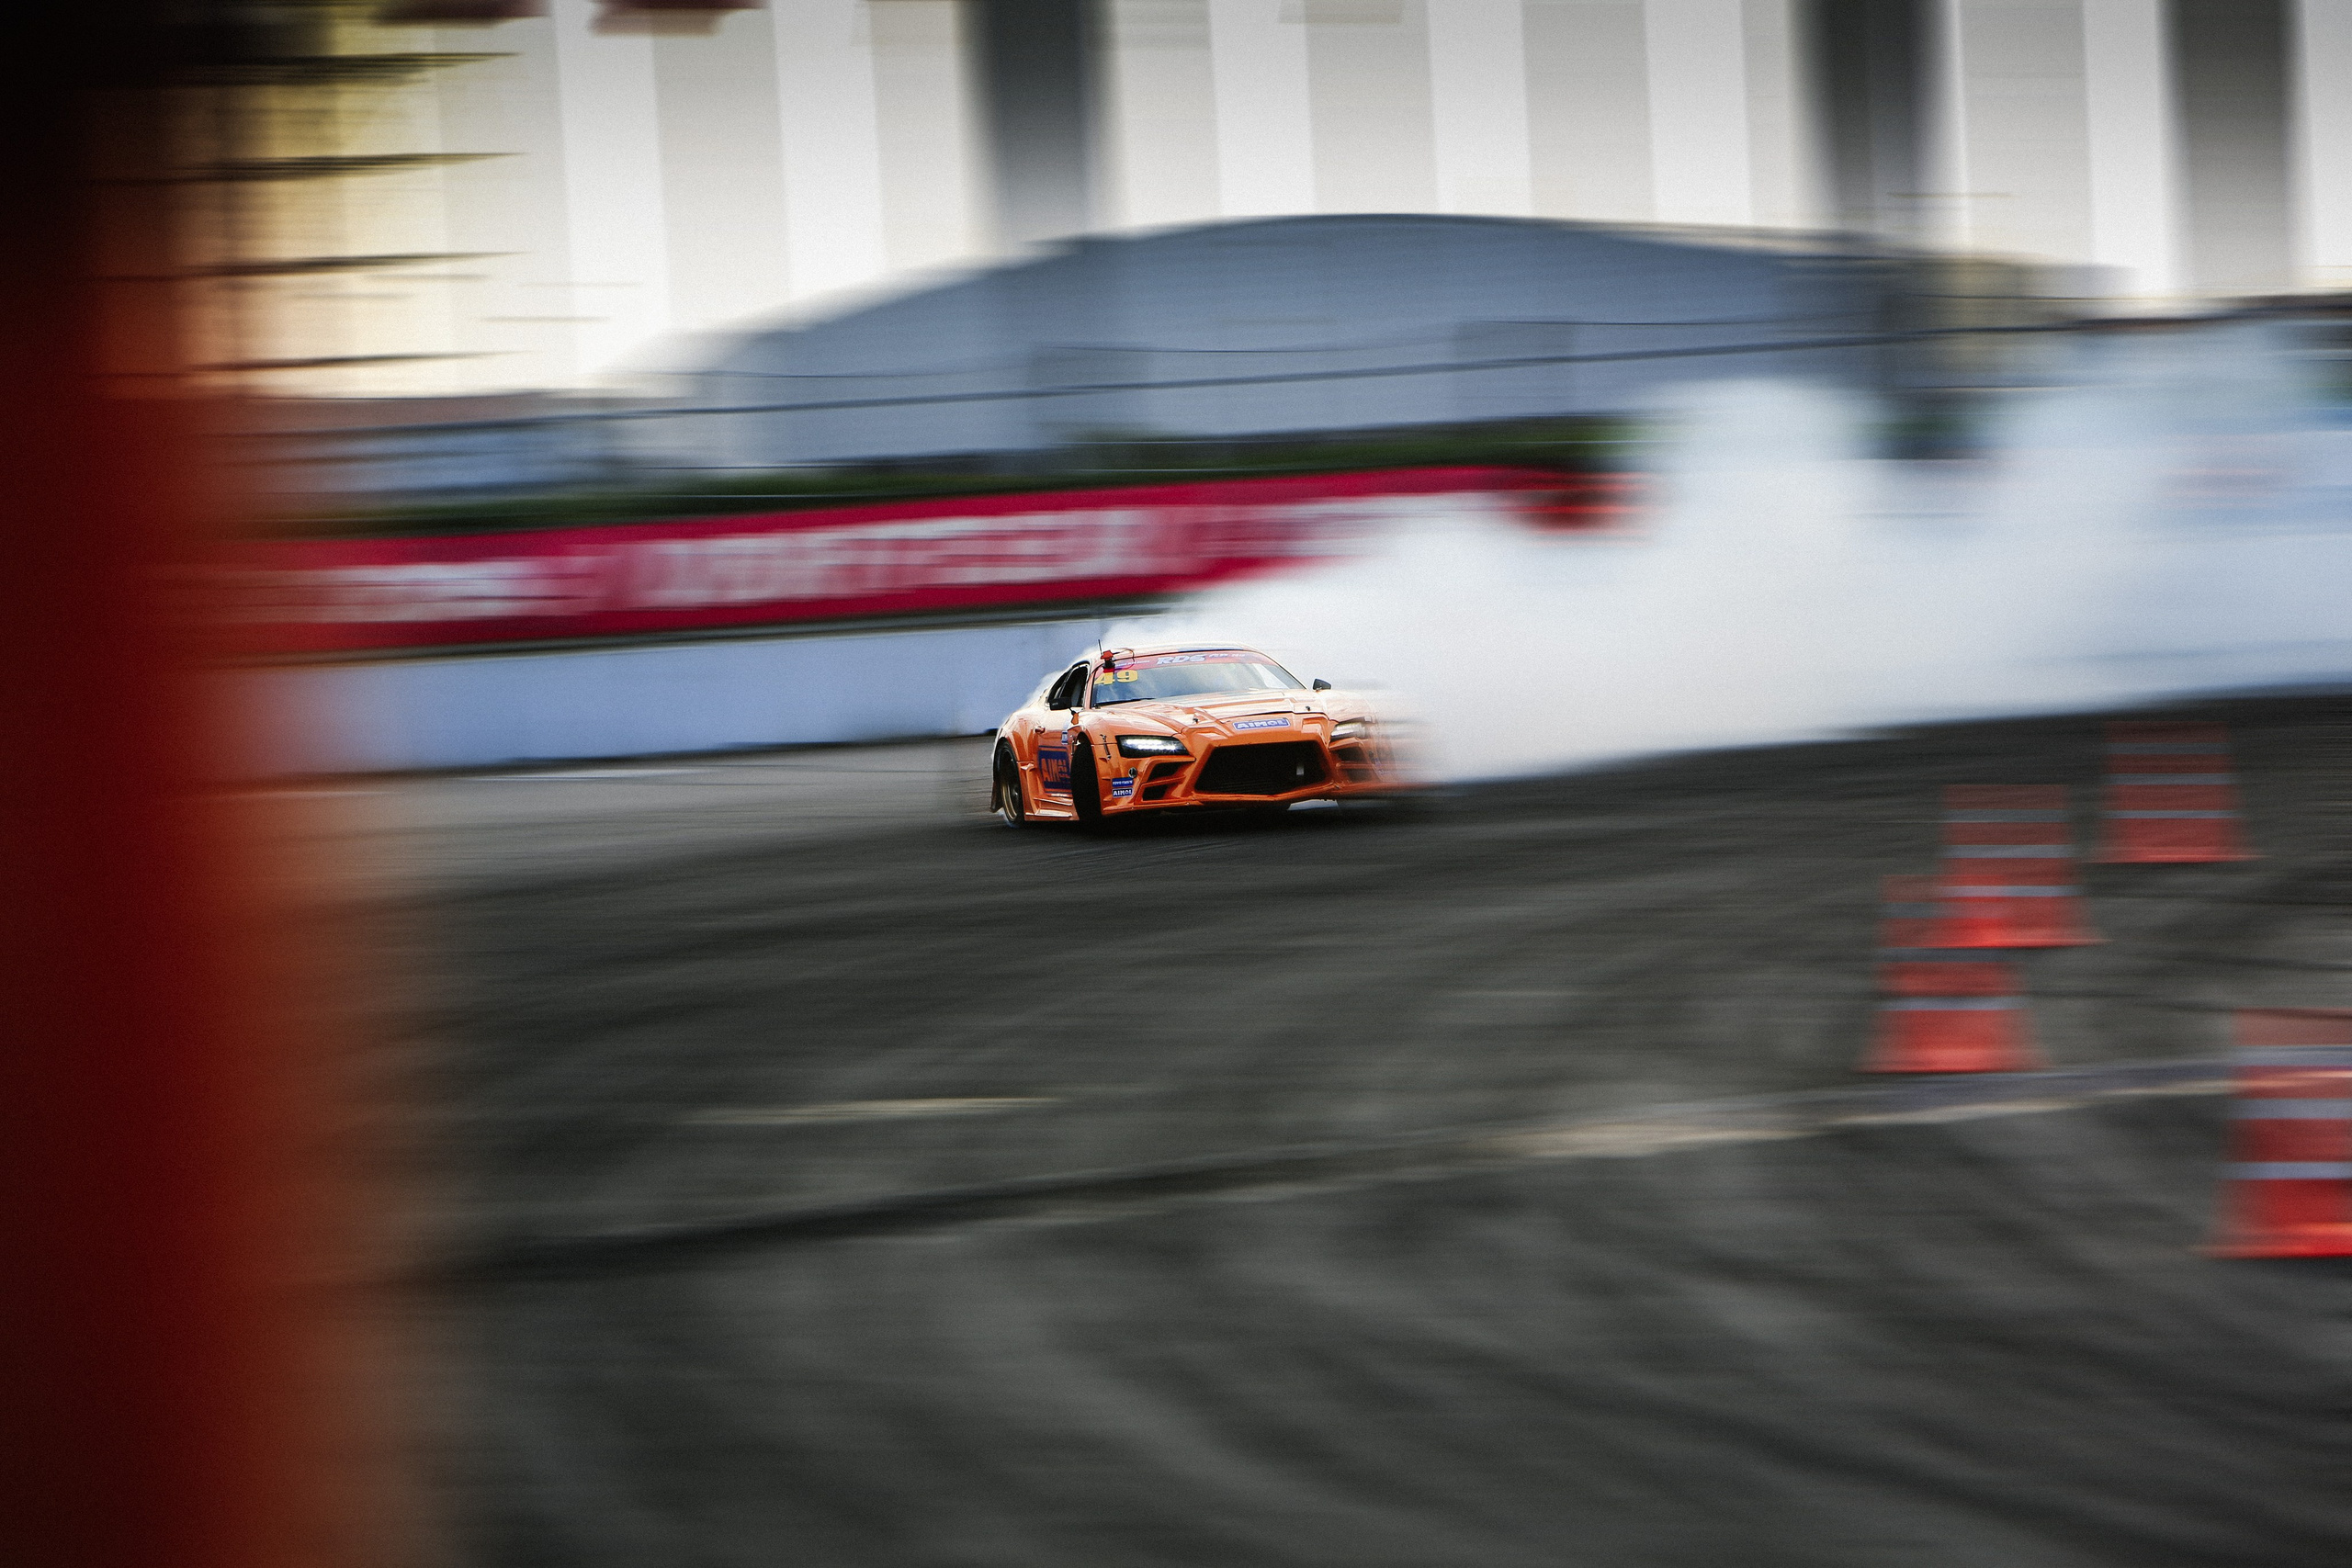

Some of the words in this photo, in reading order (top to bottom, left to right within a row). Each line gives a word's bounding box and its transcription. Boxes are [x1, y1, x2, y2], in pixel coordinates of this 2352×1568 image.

[1156, 653, 1206, 665] RDS
[1094, 669, 1138, 685] 49
[1238, 719, 1287, 729] AIMOL
